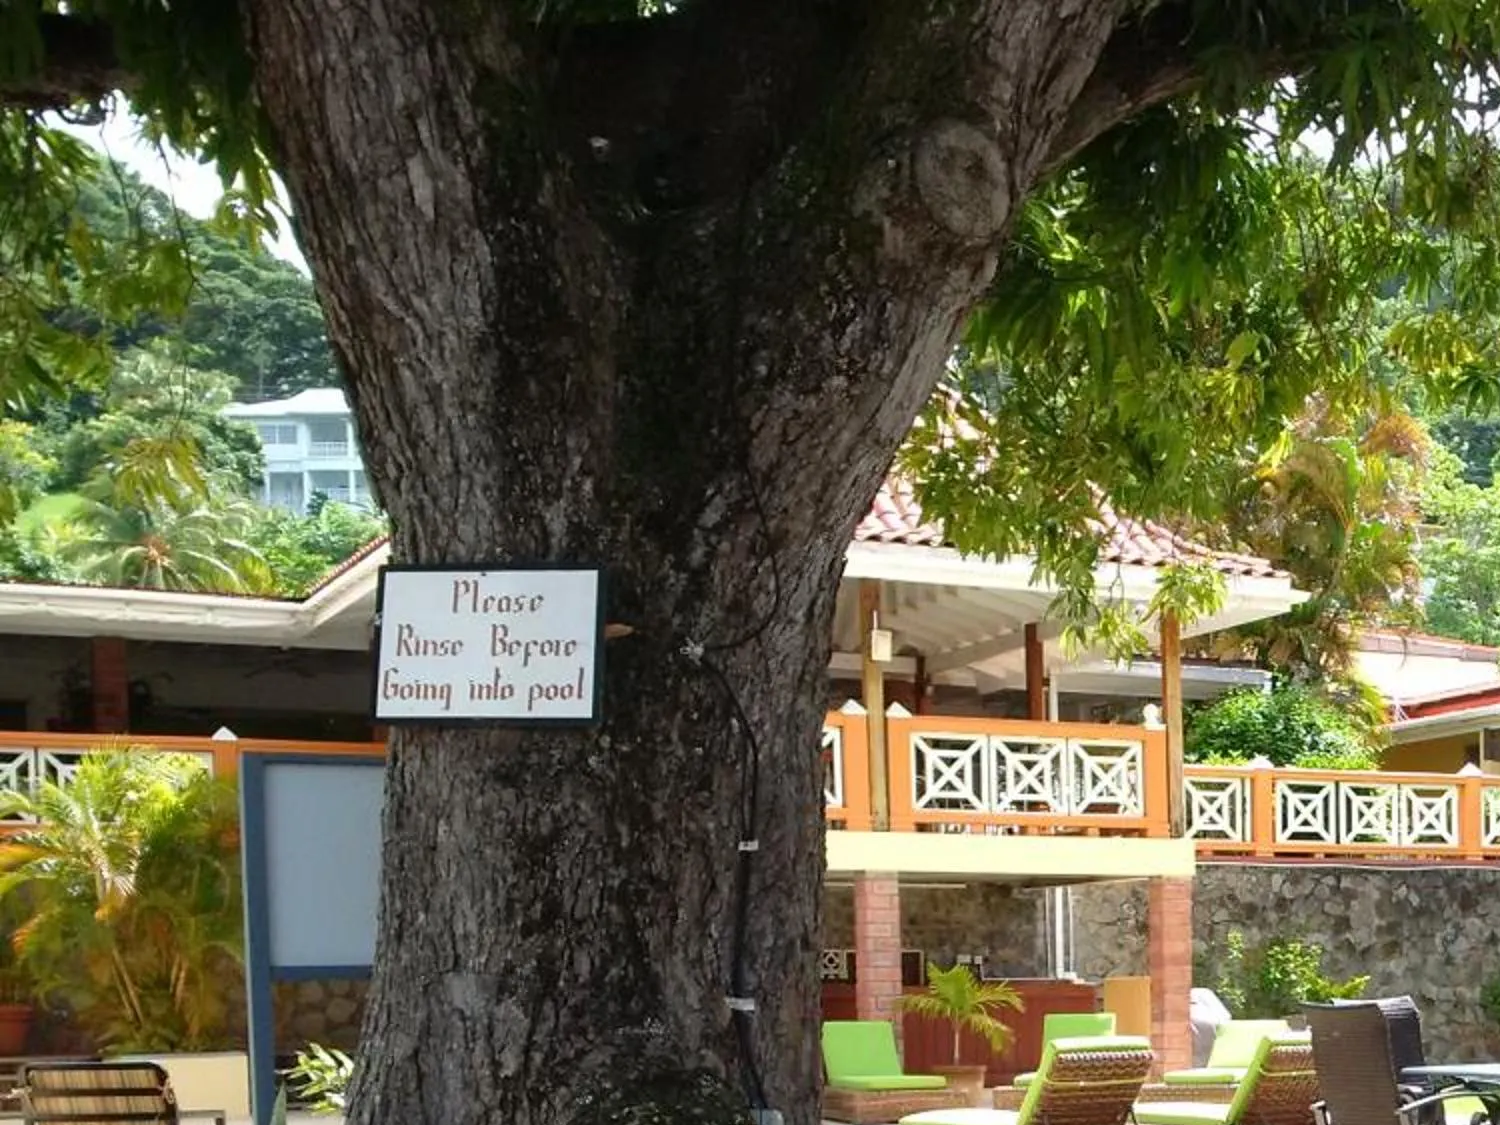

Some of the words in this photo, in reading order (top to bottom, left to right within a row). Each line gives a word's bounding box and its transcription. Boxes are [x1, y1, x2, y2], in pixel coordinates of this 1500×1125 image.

[452, 580, 544, 614] Please
[396, 624, 464, 657] Rinse
[491, 624, 577, 667] Before
[383, 667, 452, 711] Going
[469, 668, 514, 701] into
[528, 667, 584, 711] pool
